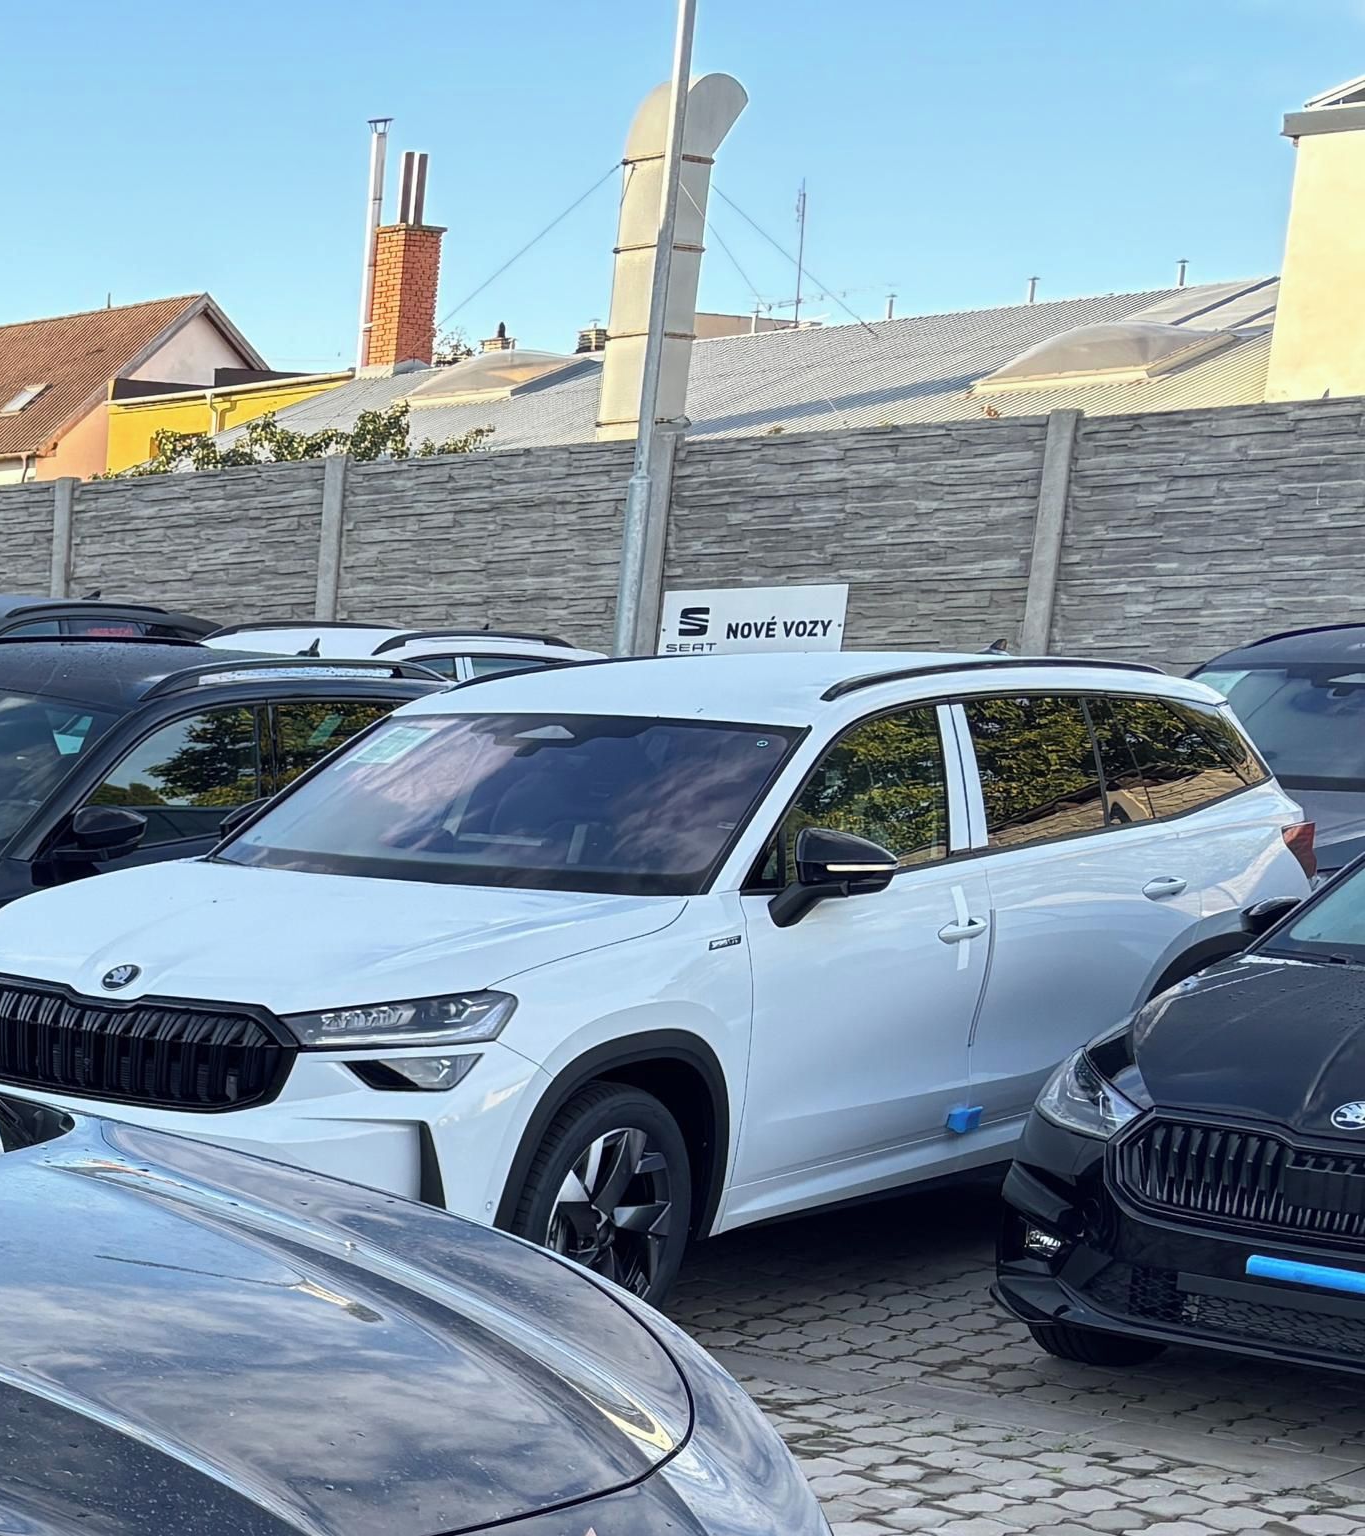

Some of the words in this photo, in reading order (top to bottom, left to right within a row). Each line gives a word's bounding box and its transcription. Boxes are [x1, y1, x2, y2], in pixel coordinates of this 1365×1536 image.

[725, 615, 778, 640] NOVÉ
[782, 619, 833, 638] VOZY
[665, 642, 718, 653] SEAT
